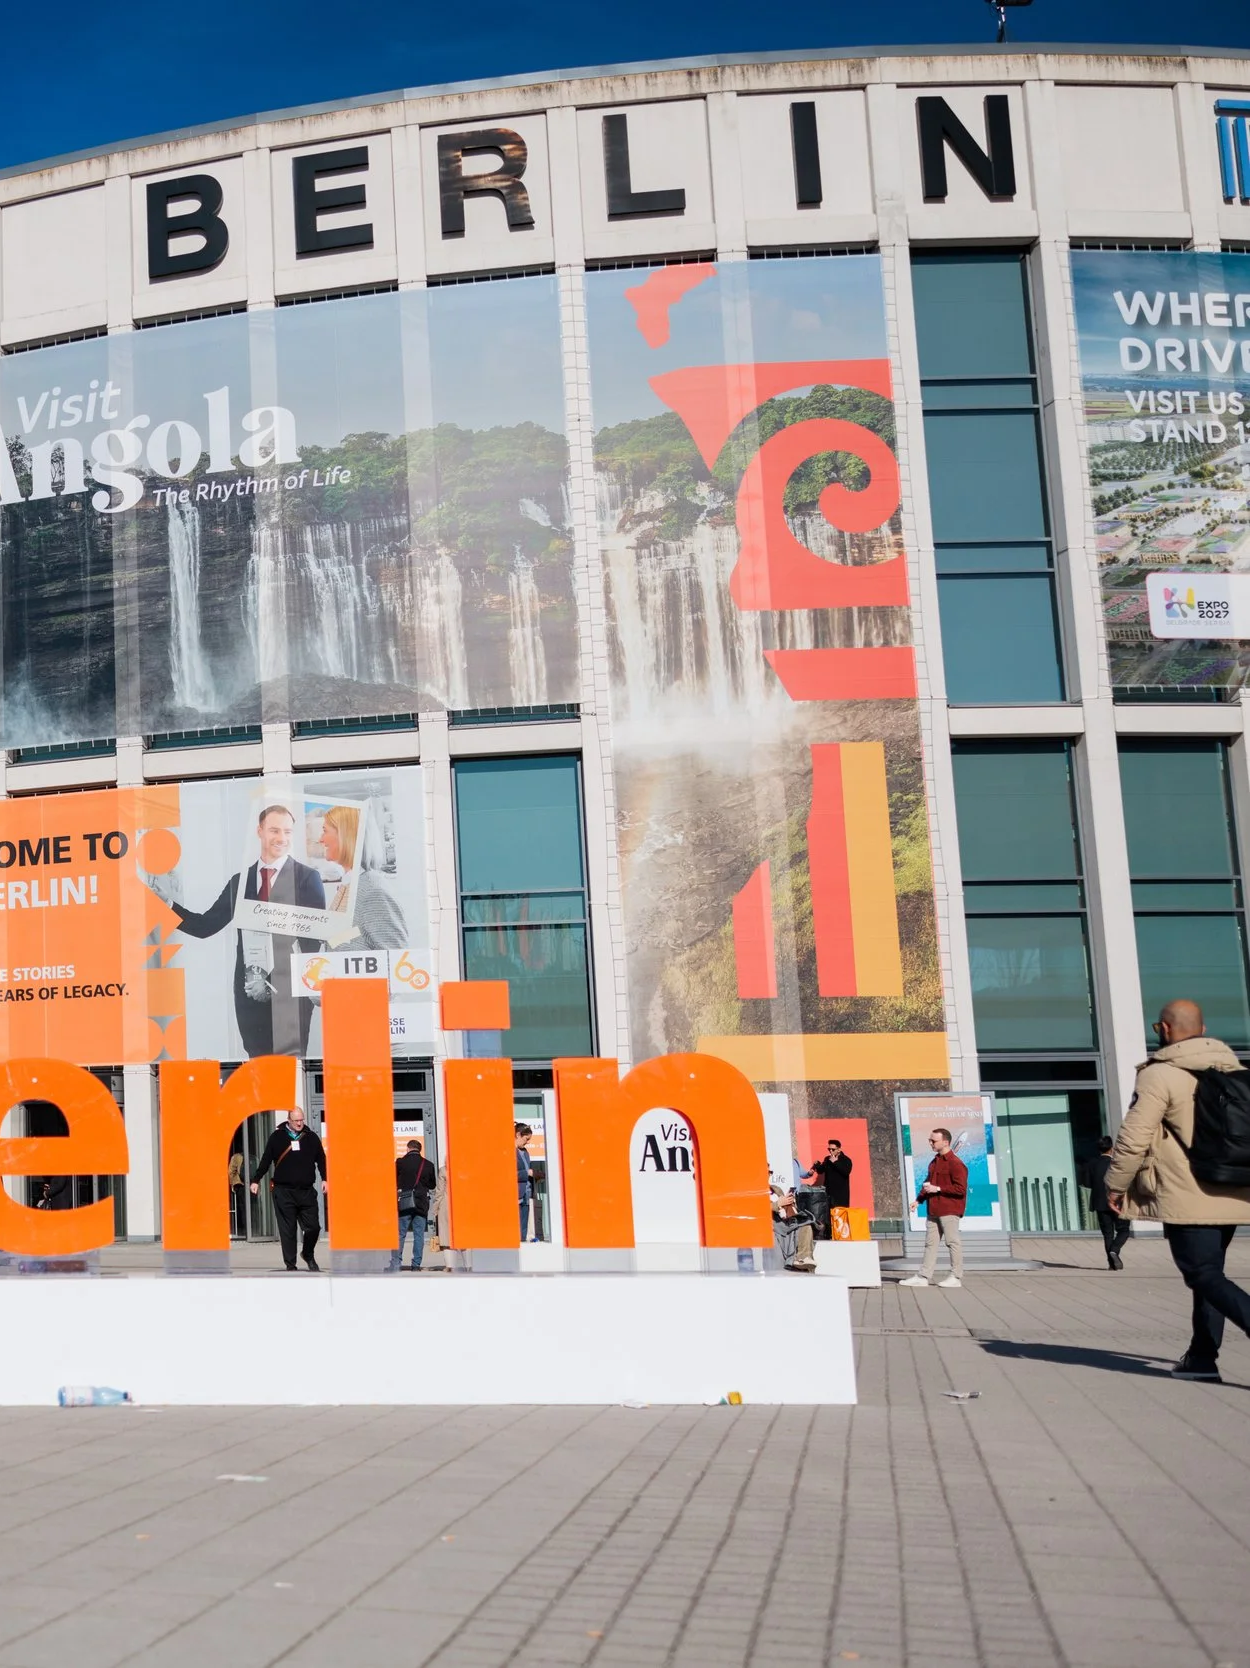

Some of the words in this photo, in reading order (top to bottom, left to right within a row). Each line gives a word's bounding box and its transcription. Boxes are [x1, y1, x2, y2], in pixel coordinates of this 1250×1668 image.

[146, 94, 1016, 280] BERLIN
[17, 379, 121, 434] Visit
[1124, 390, 1200, 415] VISIT
[1207, 391, 1245, 416] US
[1129, 419, 1227, 444] STAND
[153, 488, 190, 506] The
[196, 476, 278, 503] Rhythm
[284, 469, 309, 489] of
[312, 465, 351, 487] Life
[1197, 601, 1229, 610] EXPO
[1198, 610, 1230, 619] 2027
[83, 831, 129, 861] TO
[253, 904, 288, 920] Creating
[291, 912, 329, 924] moments
[266, 921, 287, 930] since
[292, 923, 311, 932] 1966
[12, 964, 75, 982] STORIES
[344, 957, 378, 974] ITB
[38, 986, 59, 999] OF
[63, 983, 129, 999] LEGACY.
[391, 1027, 406, 1035] LIN
[639, 1134, 695, 1180] An
[771, 1175, 786, 1183] Life
